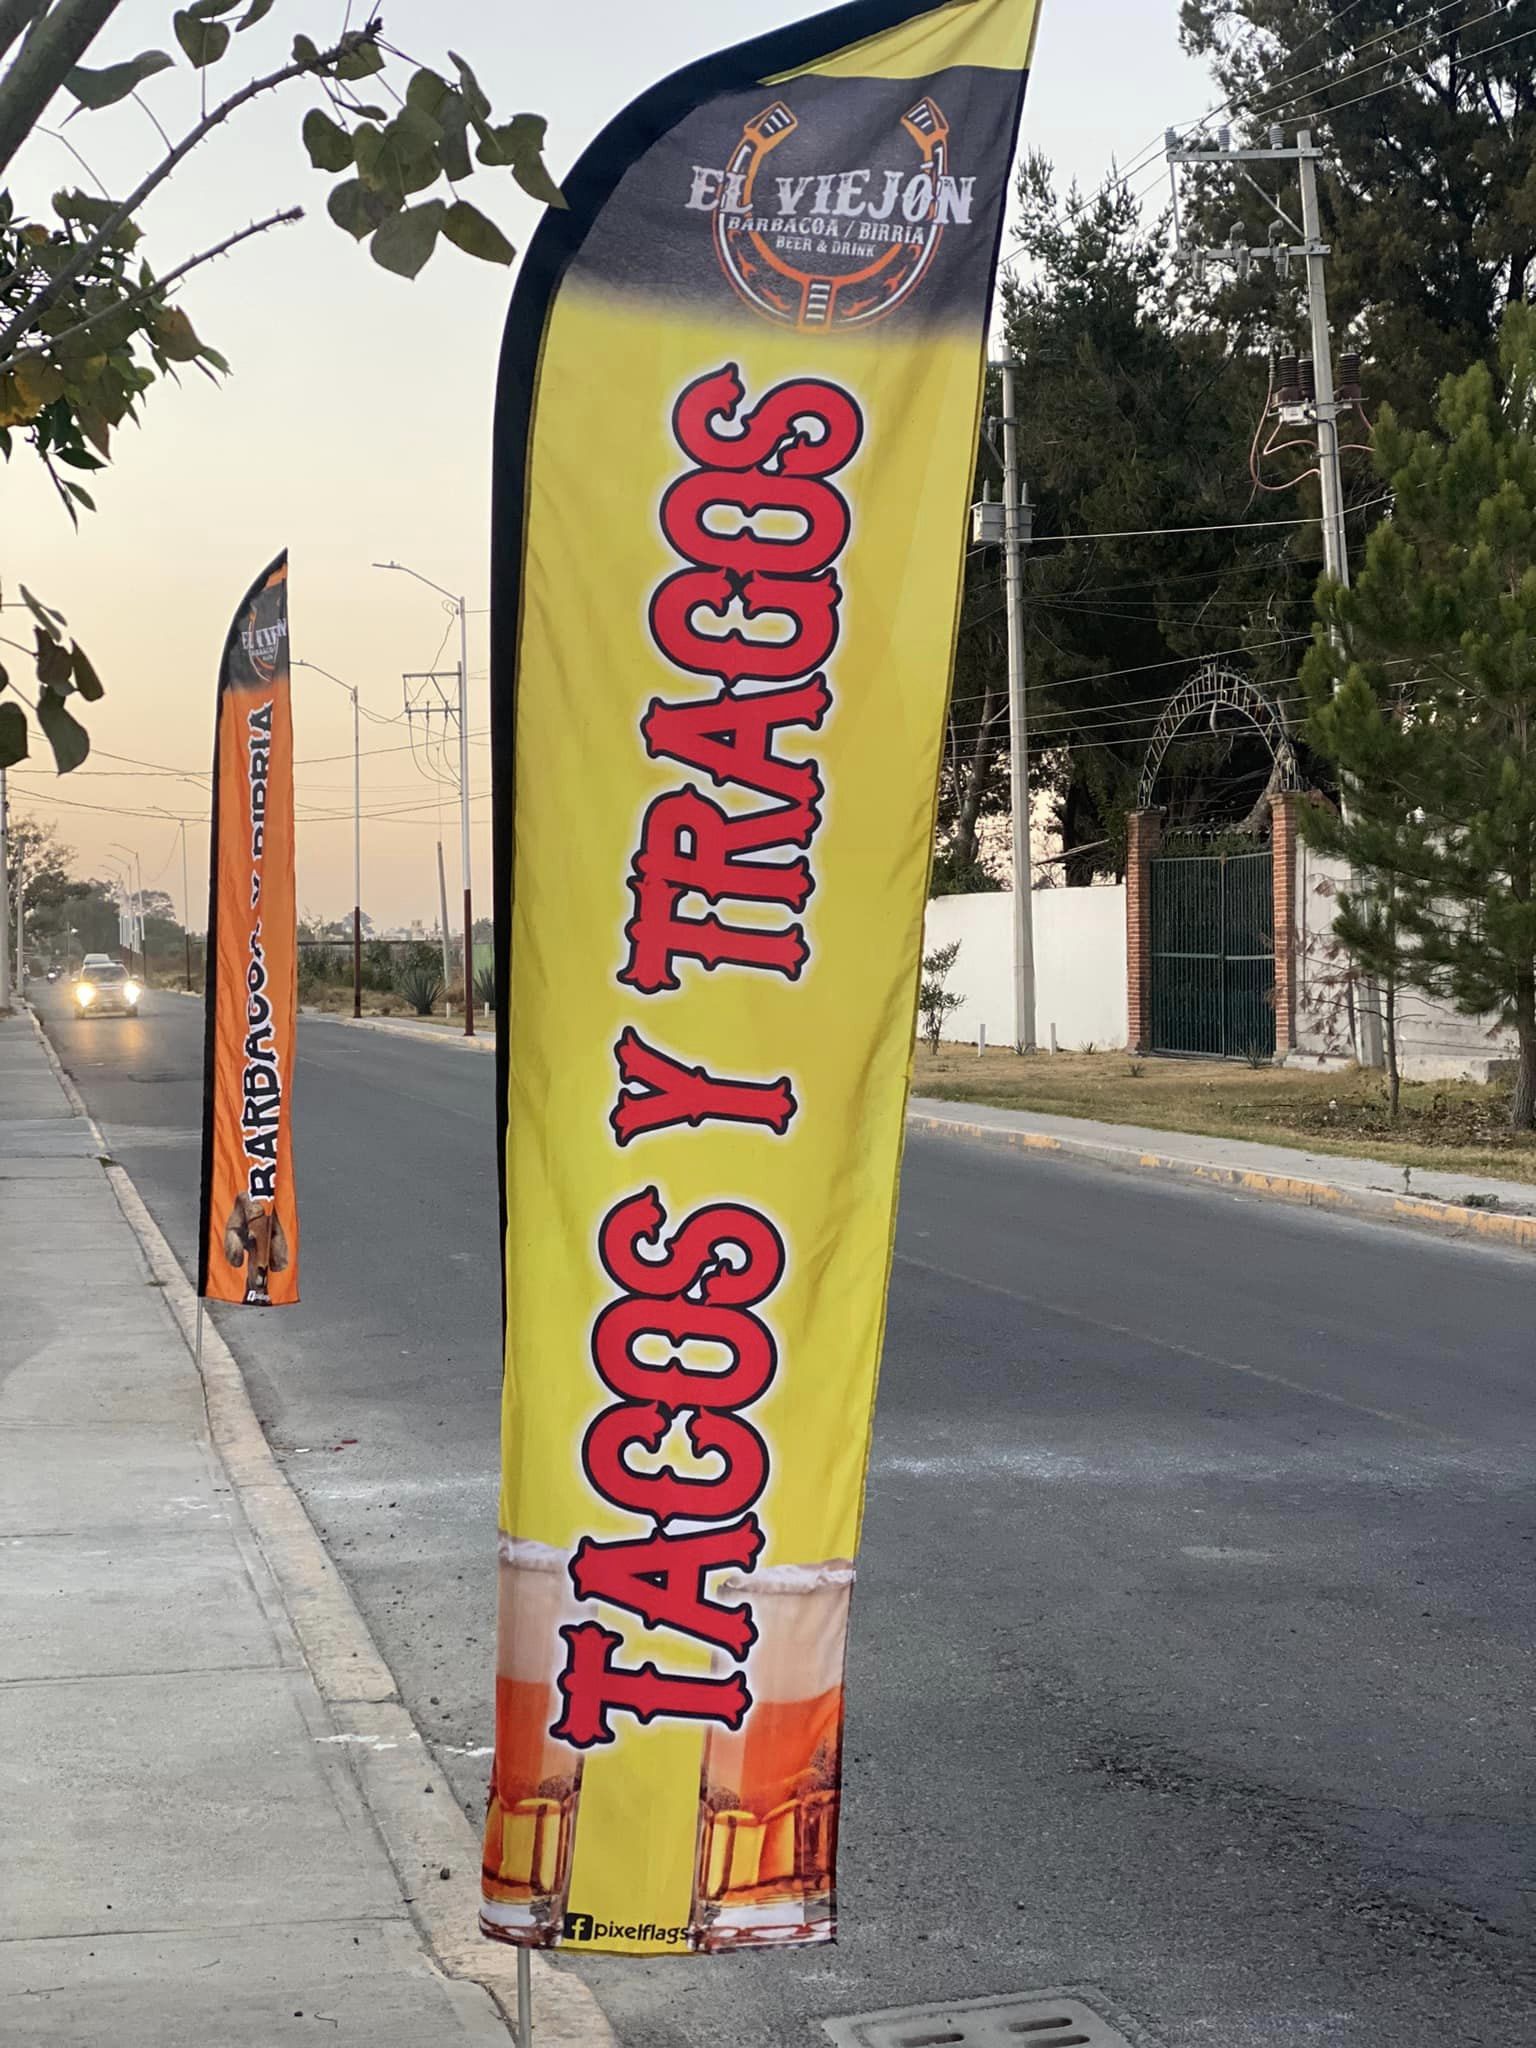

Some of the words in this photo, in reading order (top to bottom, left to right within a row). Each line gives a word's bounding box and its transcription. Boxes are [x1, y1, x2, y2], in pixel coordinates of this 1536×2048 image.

[685, 165, 753, 213] EL
[728, 216, 839, 238] BARBACOA
[858, 222, 925, 245] BIRRIA
[776, 235, 812, 252] BEER
[816, 241, 828, 254] &
[831, 242, 876, 258] DRINK
[617, 362, 865, 995] TRAGOS
[609, 1026, 798, 1148] Y
[549, 1185, 786, 1749] TACOS
[594, 1921, 690, 1945] pixelflags
